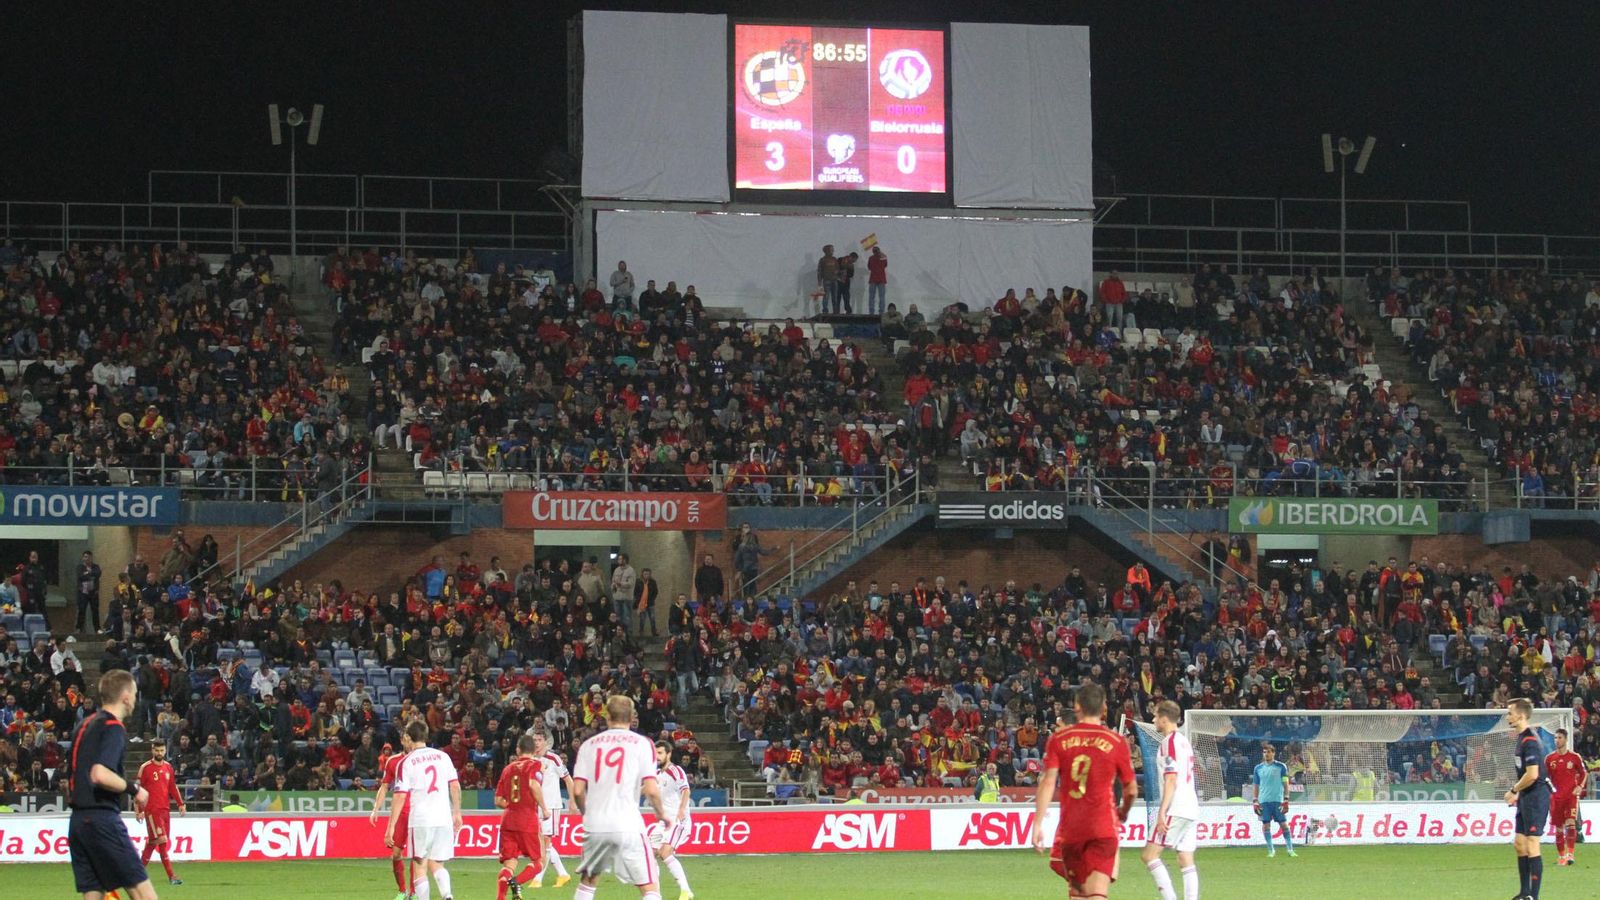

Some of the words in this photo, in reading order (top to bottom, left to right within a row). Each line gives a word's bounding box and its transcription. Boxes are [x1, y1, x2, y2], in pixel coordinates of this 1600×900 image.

[813, 42, 867, 62] 86:55
[765, 142, 785, 171] 3
[897, 145, 917, 174] 0
[818, 174, 864, 183] QUALIFIERS
[13, 491, 163, 518] movistar
[532, 492, 678, 528] Cruzcampo
[688, 500, 699, 523] SIN
[988, 500, 1065, 520] adidas
[1278, 503, 1429, 526] IBERDROLA
[153, 772, 159, 781] 3
[595, 746, 625, 784] 19
[1069, 754, 1092, 799] 9
[425, 765, 440, 795] 2
[511, 775, 521, 803] 8
[238, 820, 328, 857] ASM
[811, 813, 897, 849] ASM
[958, 812, 1035, 846] ASM
[1373, 814, 1408, 838] de
[1417, 813, 1444, 837] la
